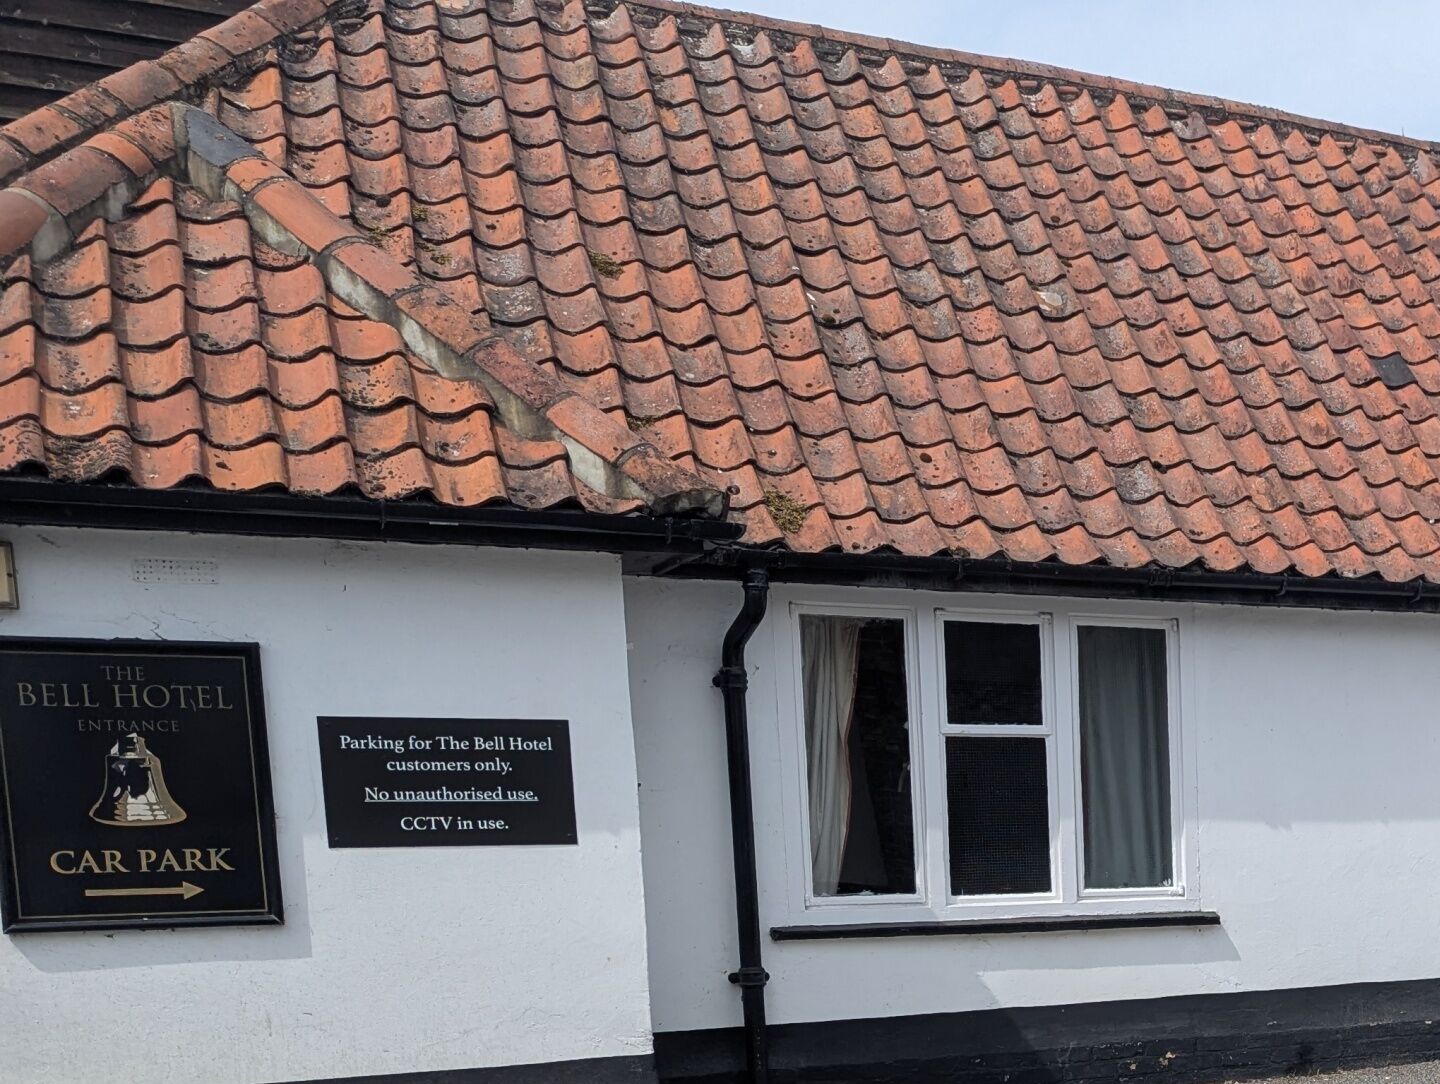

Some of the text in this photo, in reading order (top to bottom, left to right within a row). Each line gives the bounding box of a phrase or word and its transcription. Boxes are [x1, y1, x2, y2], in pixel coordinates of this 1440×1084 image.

[100, 665, 145, 681] THE
[16, 682, 233, 710] BELL HOTEL
[77, 719, 180, 732] ENTRANCE
[339, 735, 553, 753] Parking for The Bell Hotel
[386, 758, 513, 775] customers only.
[364, 787, 539, 802] No unauthorised use.
[400, 817, 509, 830] CCTV in use.
[50, 848, 235, 874] CAR PARK
